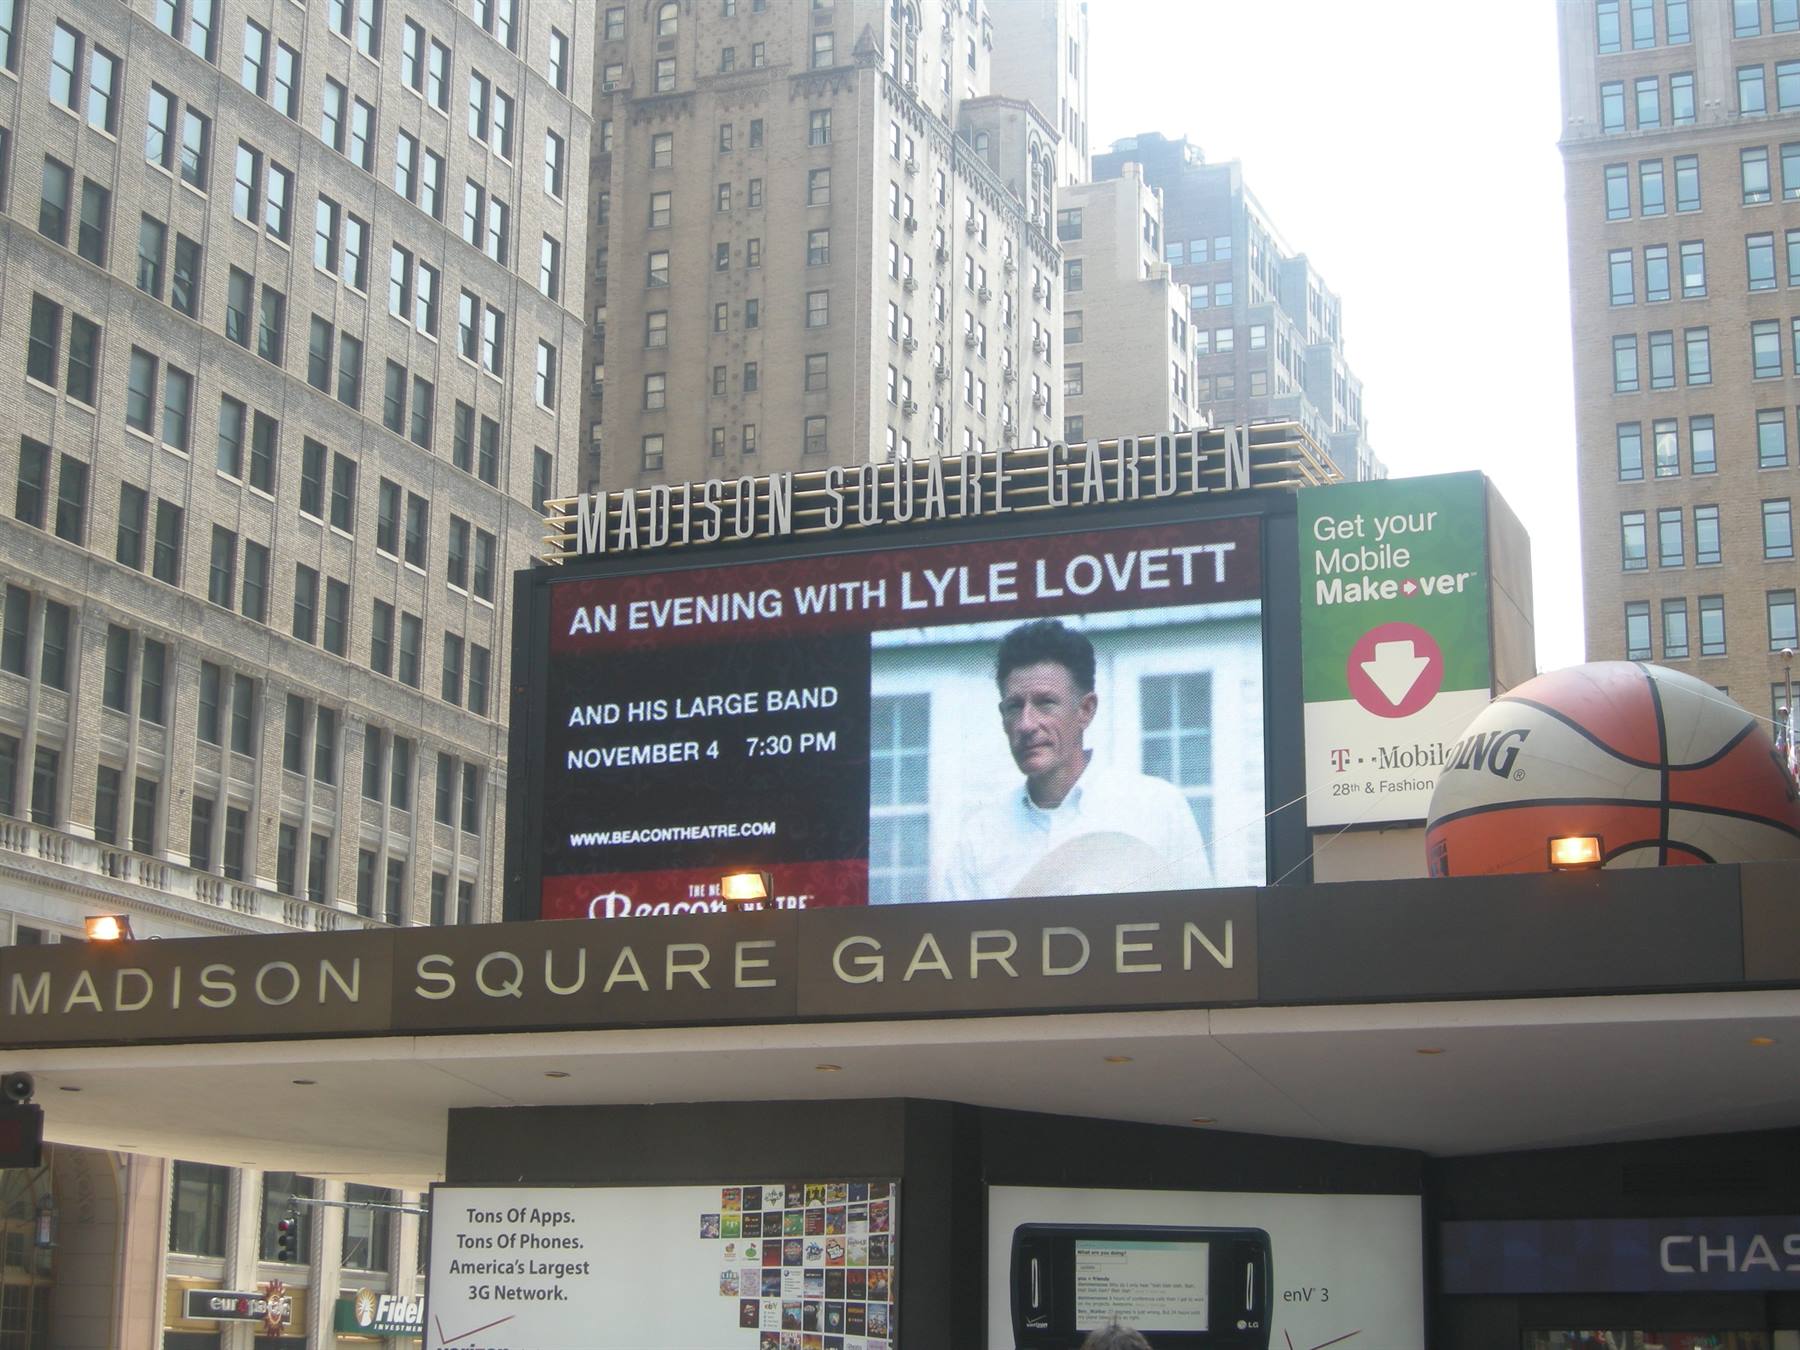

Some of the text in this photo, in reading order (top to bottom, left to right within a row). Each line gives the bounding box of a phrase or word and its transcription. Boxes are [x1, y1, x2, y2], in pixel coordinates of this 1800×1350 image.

[576, 424, 1251, 555] MADISON SQUARE GARDEN
[1313, 511, 1438, 541] Get your
[1315, 544, 1411, 575] Mobile
[569, 542, 1236, 636] AN EVENING WITH LYLE LOVETT
[568, 686, 839, 727] AND HIS LARGE BAND
[568, 731, 836, 770] NOVEMBER 4 7:30 PM
[1332, 779, 1434, 797] 28th & Fashion
[570, 821, 776, 847] WWW.BEACONTHEATRE.COM
[10, 919, 1234, 1015] MADISON SQUARE GARDEN
[466, 1207, 576, 1227] Tons Of Apps.
[456, 1233, 584, 1249] Tons Of Phones.
[449, 1259, 590, 1278] America's Largest
[468, 1285, 568, 1301] 3G Network.
[1320, 1287, 1329, 1302] 3
